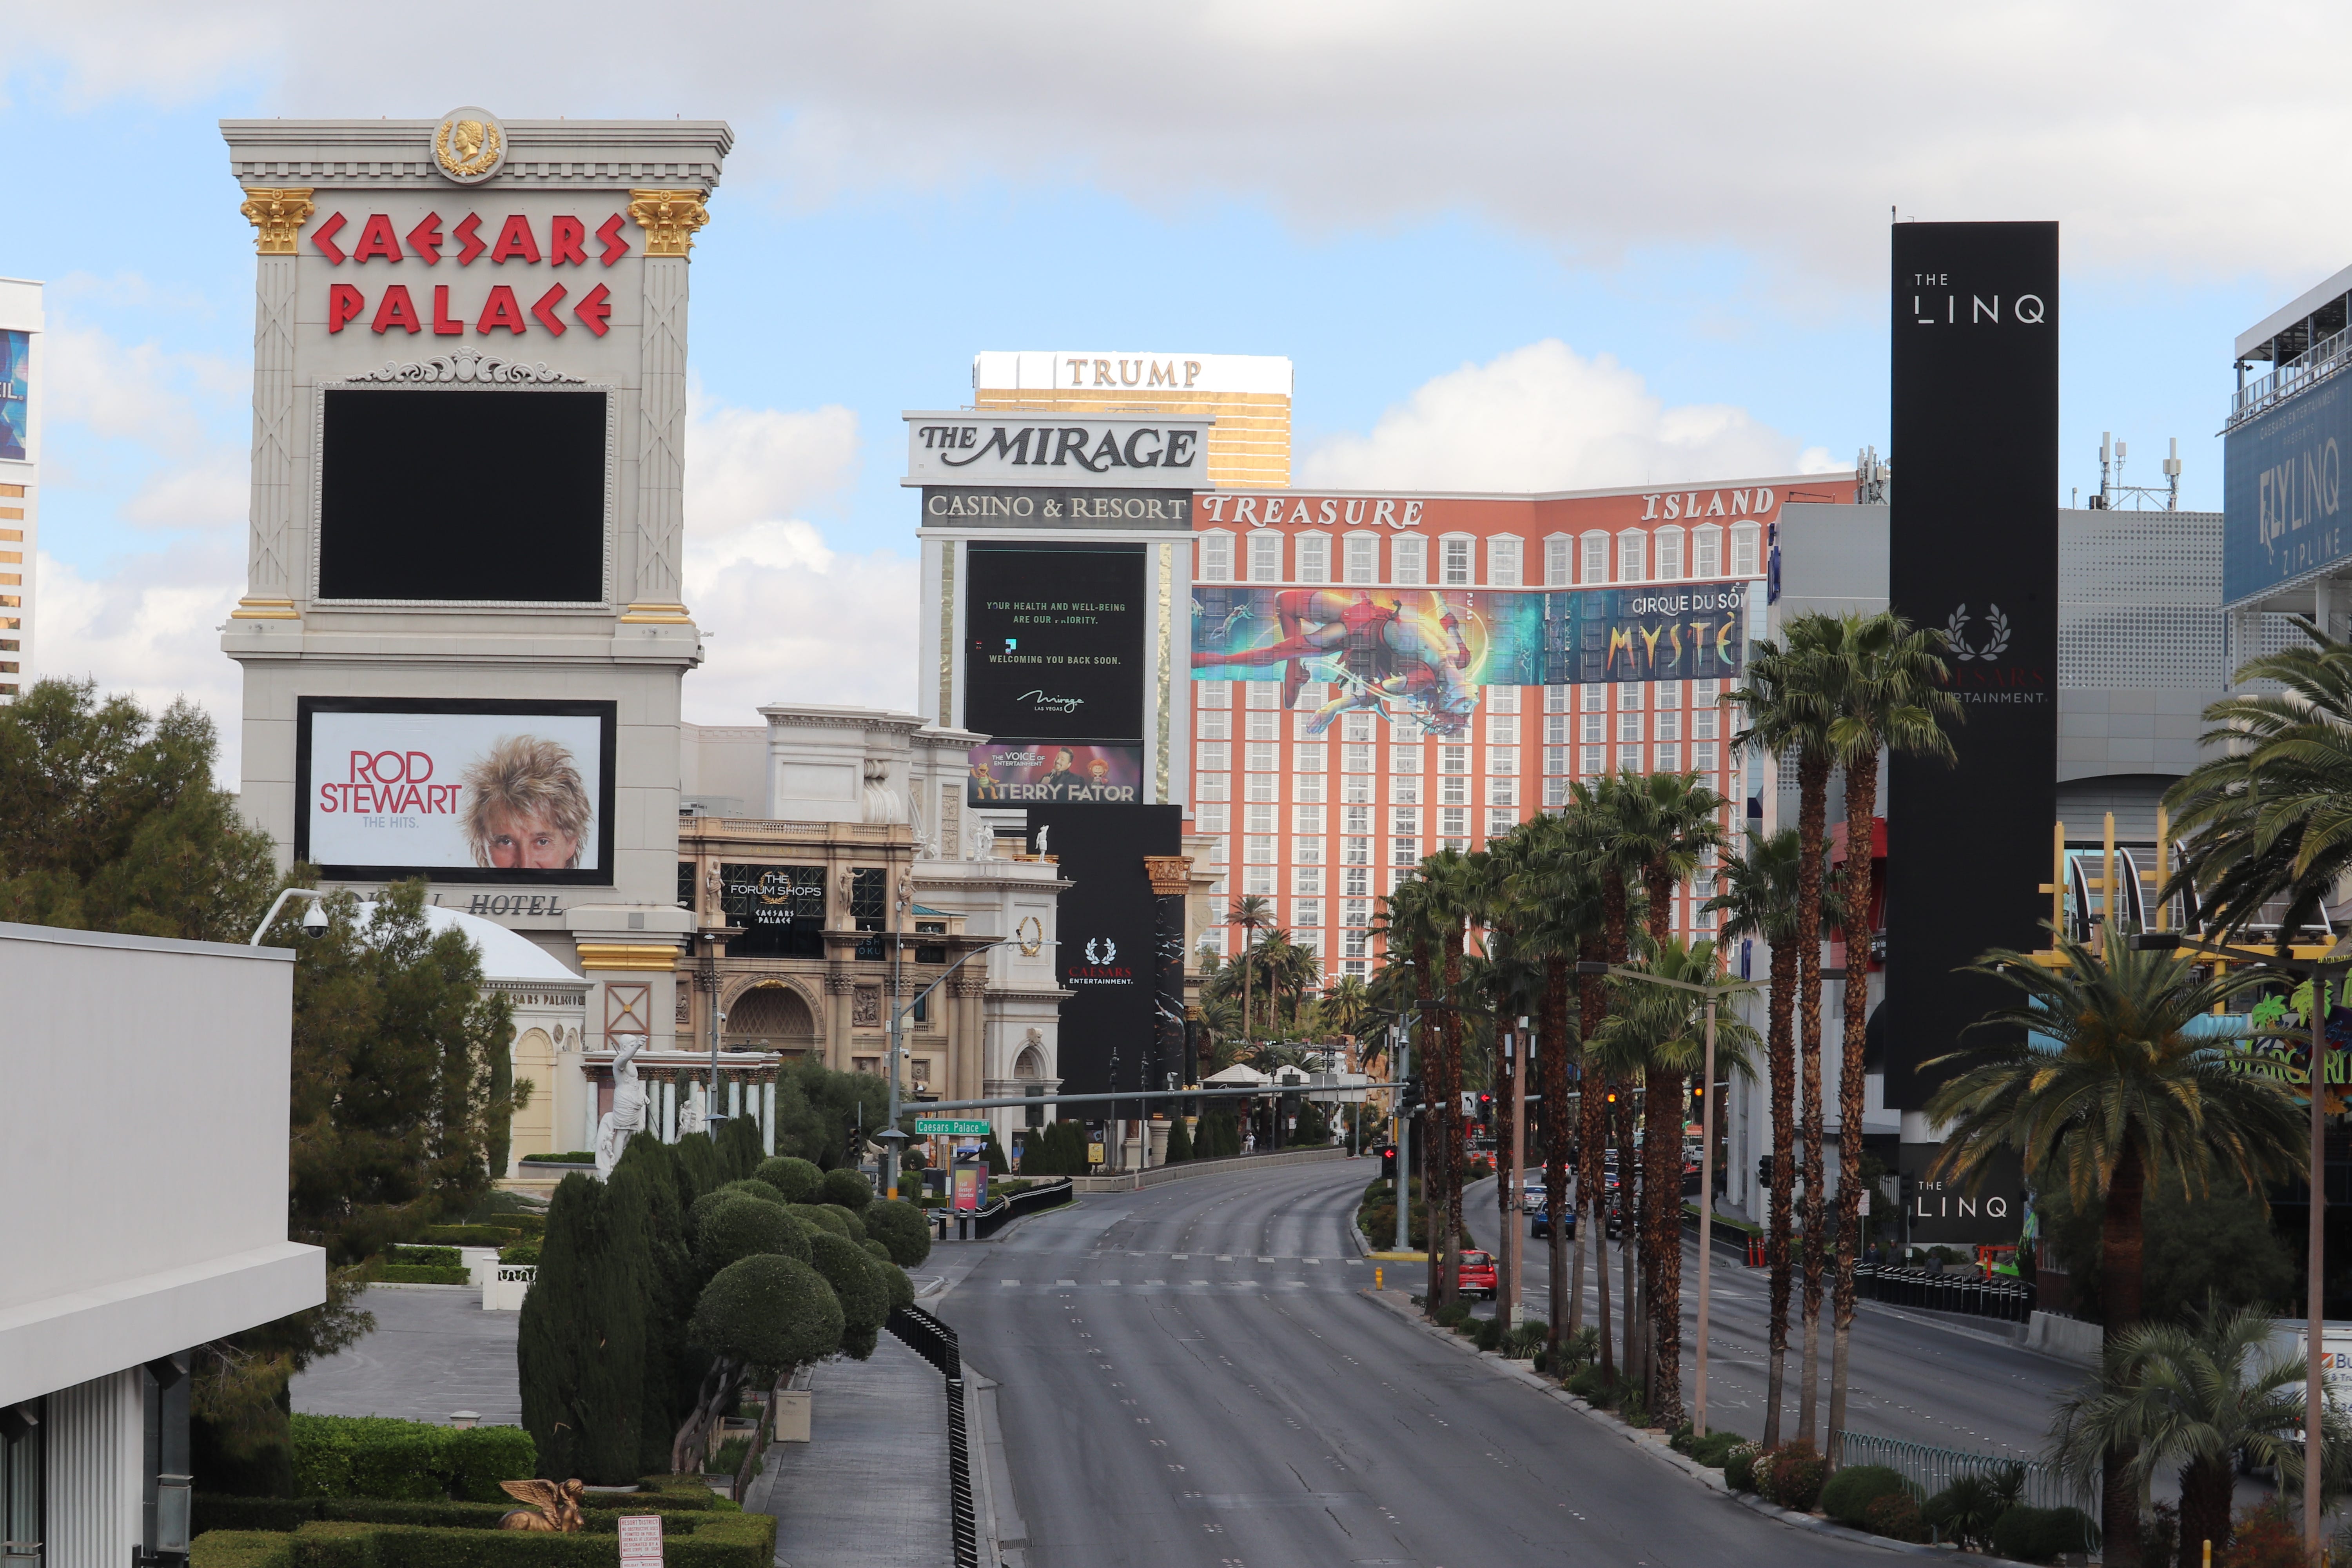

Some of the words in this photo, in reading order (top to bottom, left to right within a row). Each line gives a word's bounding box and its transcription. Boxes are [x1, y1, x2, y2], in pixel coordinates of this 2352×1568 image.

[311, 211, 630, 267] CAESARS
[1915, 274, 1947, 286] THE
[329, 282, 611, 337] PALACE
[1915, 294, 2045, 324] LINQ
[1067, 359, 1202, 386] TRUMP
[919, 426, 977, 448] THE
[2260, 416, 2287, 440] CAESARS
[941, 427, 1198, 472] MIRAGE
[2259, 437, 2339, 544] FLYLINQ
[928, 495, 1034, 517] CASINO
[1043, 498, 1063, 518] &
[1071, 498, 1187, 519] RESORT
[1202, 495, 1424, 528] TREASURE
[1641, 487, 1774, 521] ISLAND
[2283, 527, 2340, 576] ZIPLINE
[1072, 603, 1125, 612] WELL-BEING
[1632, 595, 1689, 617] CIRQUE
[1693, 594, 1715, 610] DU
[989, 655, 1042, 663] WELCOMING
[1094, 657, 1121, 665] SOON.
[350, 750, 433, 784] ROD
[1005, 752, 1036, 761] VOICE
[320, 783, 462, 814] STEWART
[995, 784, 1063, 800] TERRY
[1068, 785, 1134, 802] FATOR
[363, 816, 385, 828] THE
[390, 817, 419, 828] HITS.
[765, 875, 789, 884] THE
[731, 885, 775, 895] FORUM
[777, 886, 822, 897] SHOPS
[469, 895, 564, 915] HOTEL
[1069, 966, 1132, 977] CAESARS
[918, 1122, 949, 1132] Caesars
[954, 1122, 979, 1132] Palace
[1918, 1181, 1942, 1190] THE
[1918, 1196, 2006, 1218] LINQ
